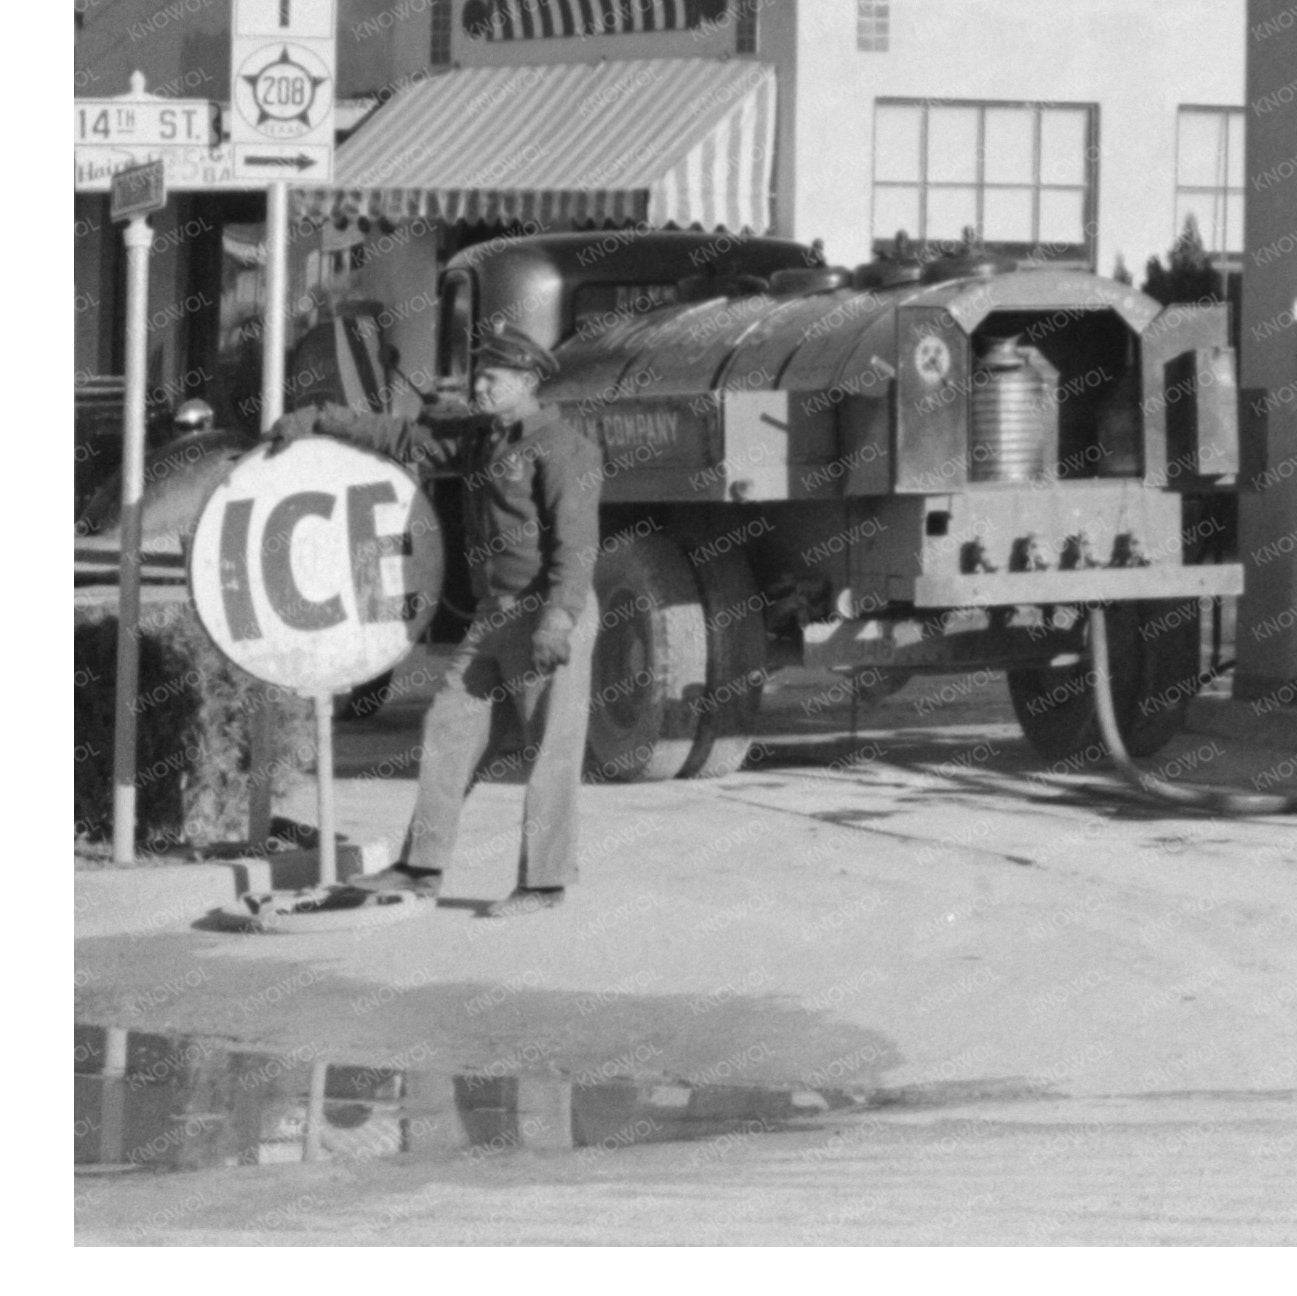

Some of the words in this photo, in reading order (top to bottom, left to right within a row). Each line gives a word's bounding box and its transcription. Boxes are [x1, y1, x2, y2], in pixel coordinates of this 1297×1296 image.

[262, 75, 305, 106] 208
[159, 108, 201, 140] ST.
[603, 412, 678, 447] COMPANY
[219, 479, 418, 642] ICE
